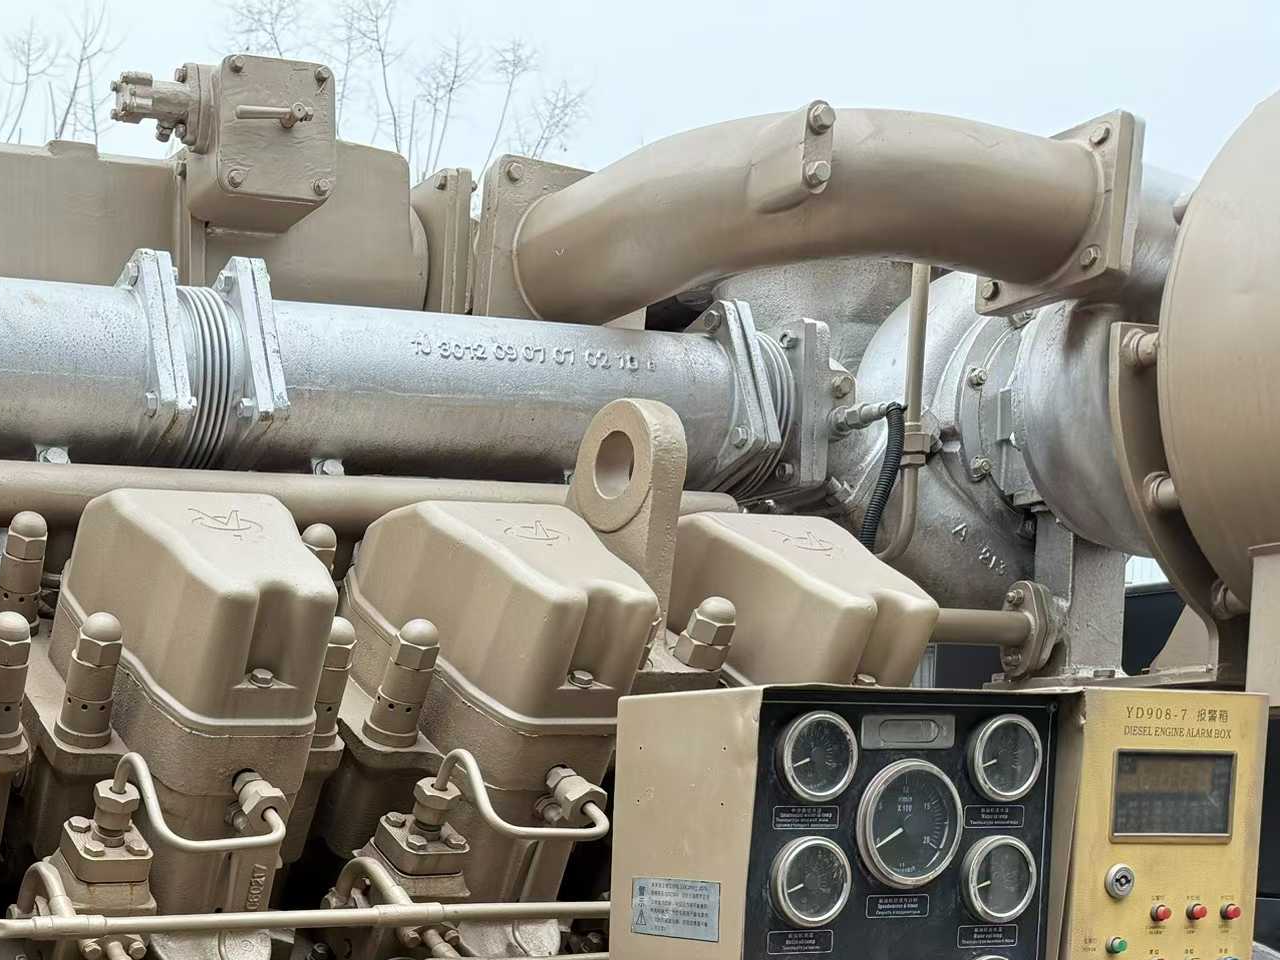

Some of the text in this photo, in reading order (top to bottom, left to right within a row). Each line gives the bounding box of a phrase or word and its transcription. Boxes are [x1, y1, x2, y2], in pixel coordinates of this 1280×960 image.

[1125, 705, 1188, 721] YD908-7
[1123, 725, 1232, 740] DIESEL ENGINE ALARM BOX
